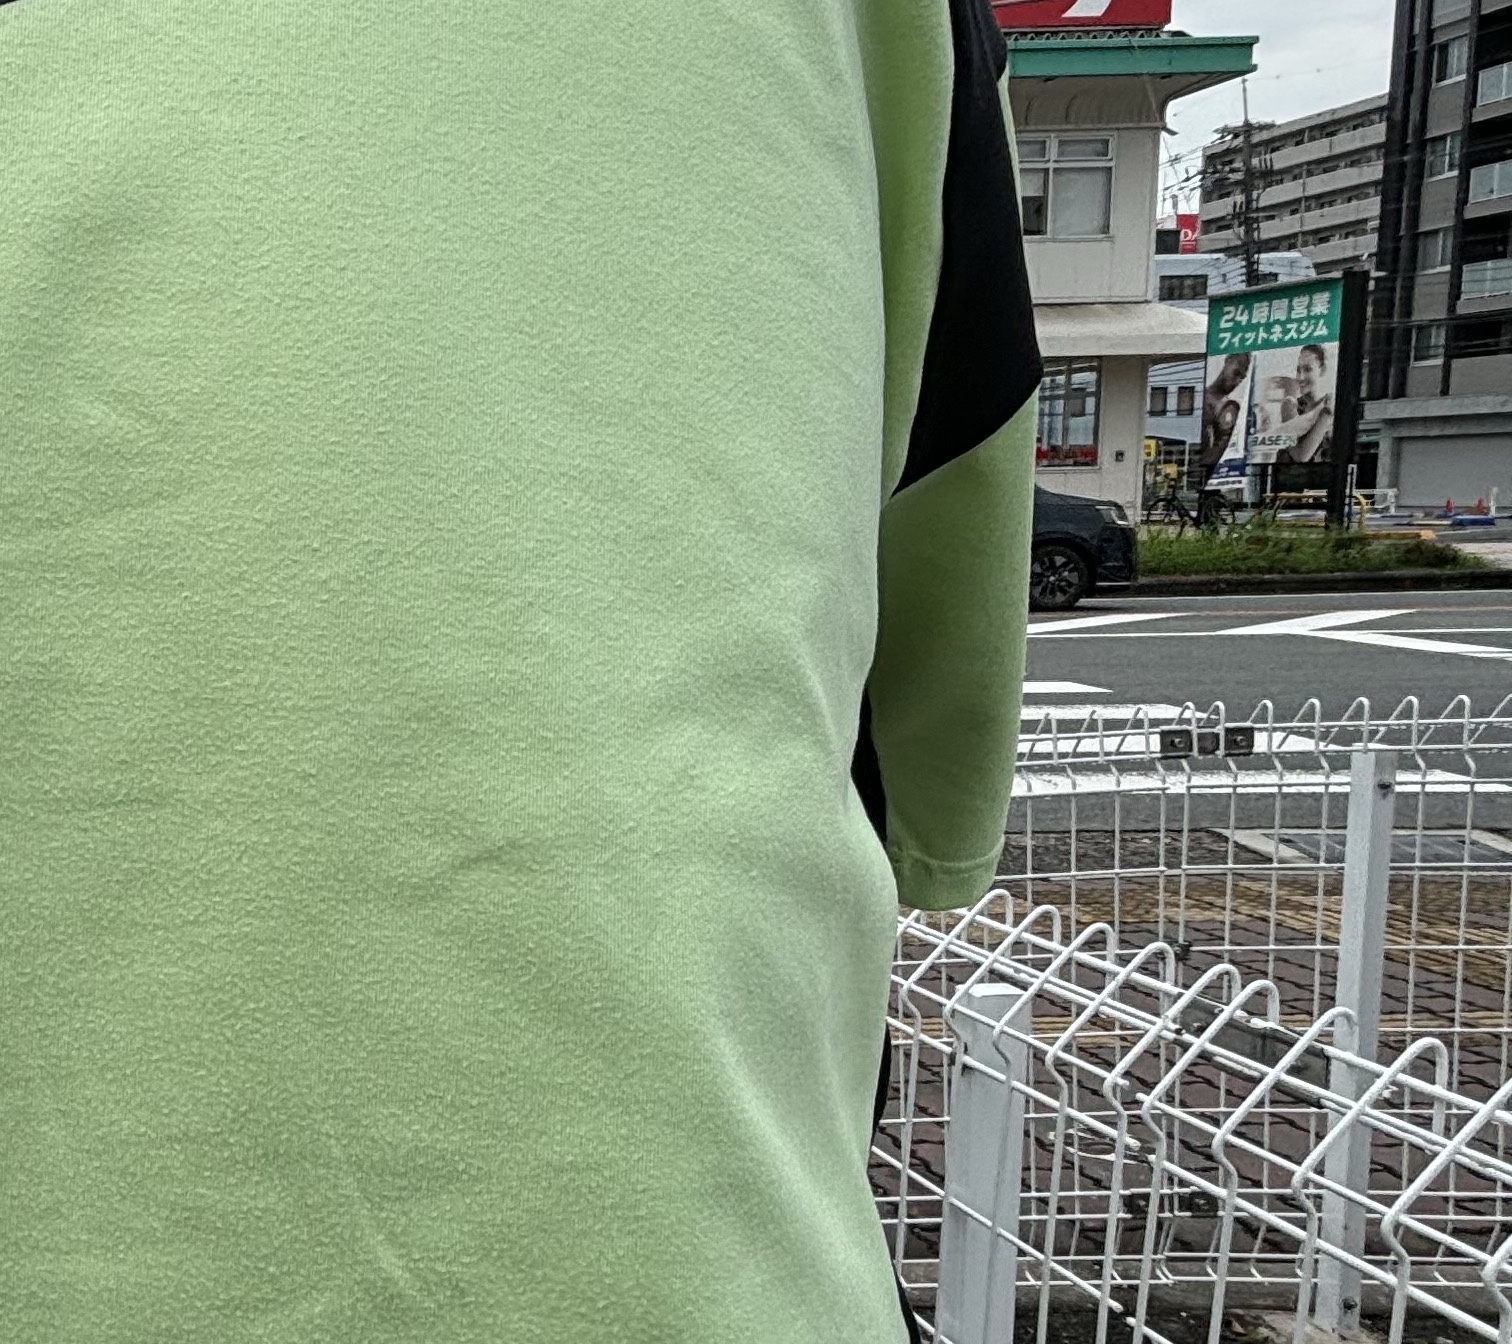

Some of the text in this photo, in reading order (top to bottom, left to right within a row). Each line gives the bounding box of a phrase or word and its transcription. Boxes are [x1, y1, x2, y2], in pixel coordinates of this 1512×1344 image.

[1219, 291, 1330, 329] 24時間営業
[1218, 318, 1328, 349] フィットネスジム
